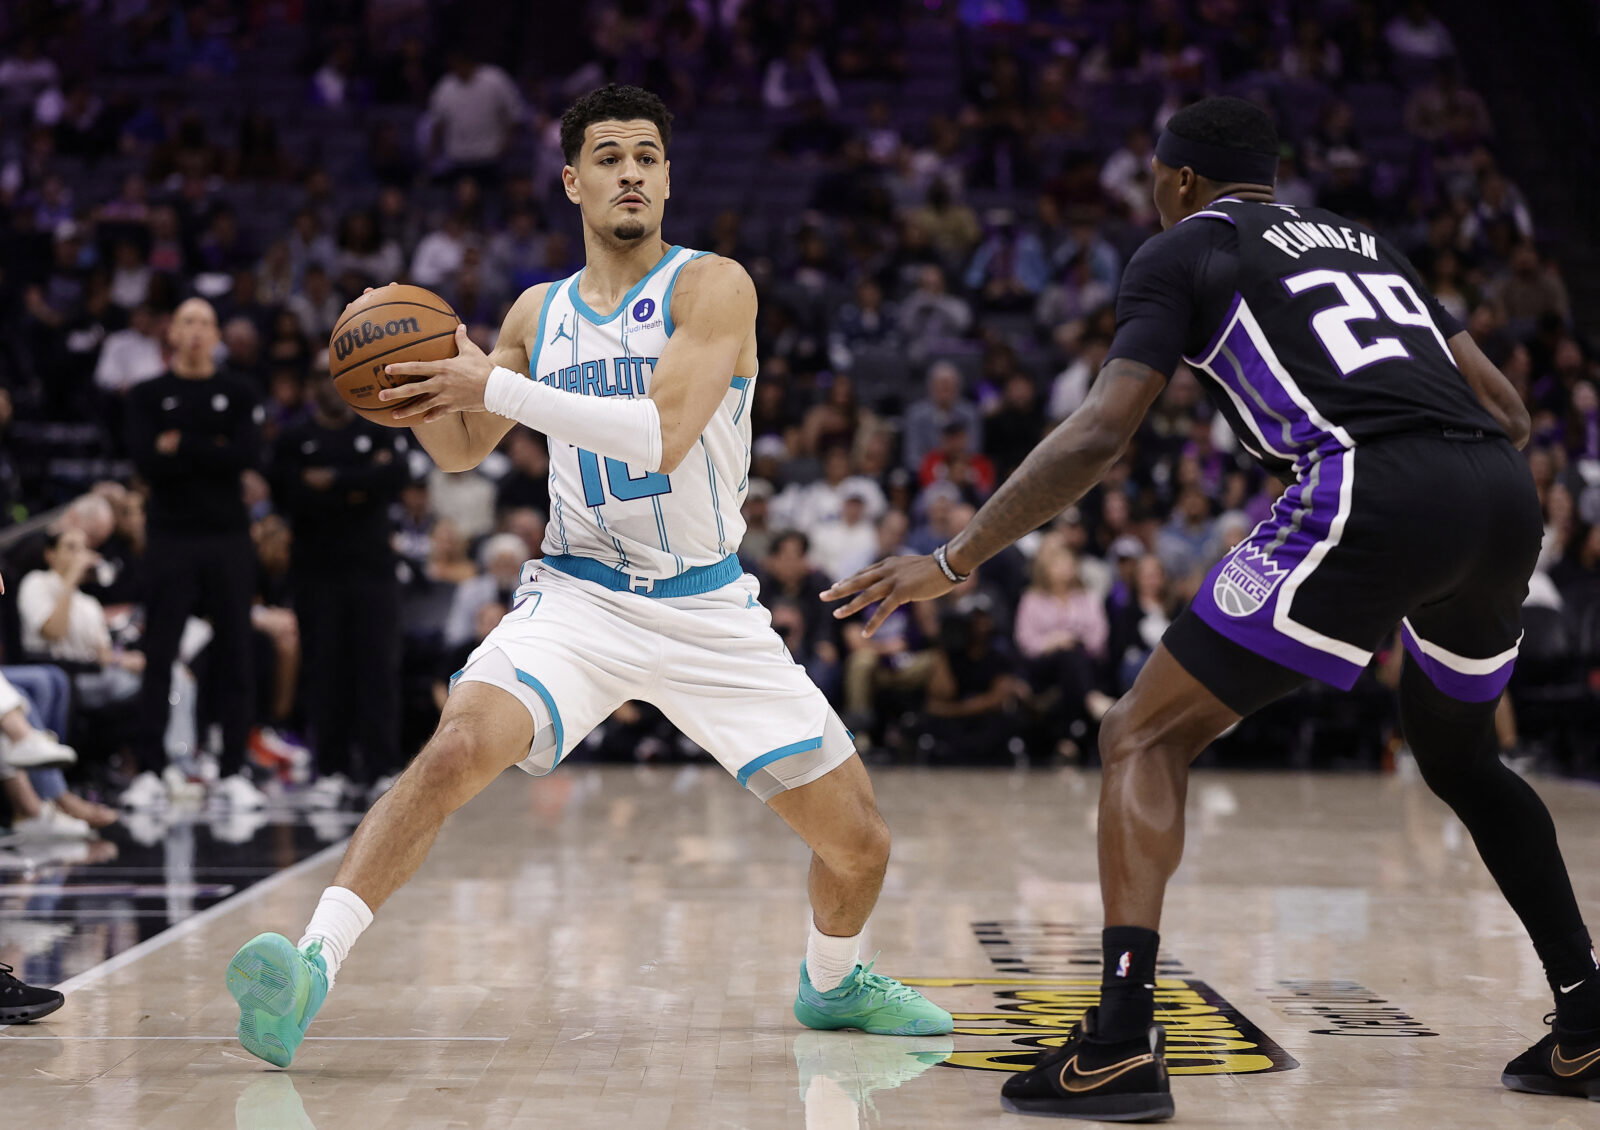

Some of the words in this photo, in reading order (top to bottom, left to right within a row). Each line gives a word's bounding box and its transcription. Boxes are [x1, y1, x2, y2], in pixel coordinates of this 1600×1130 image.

[1262, 220, 1379, 260] PLOWDEN
[334, 316, 421, 361] Wilson
[641, 318, 663, 330] Health
[1281, 268, 1458, 378] 29
[1223, 563, 1268, 603] KINGS
[1281, 1006, 1440, 1037] Credit
